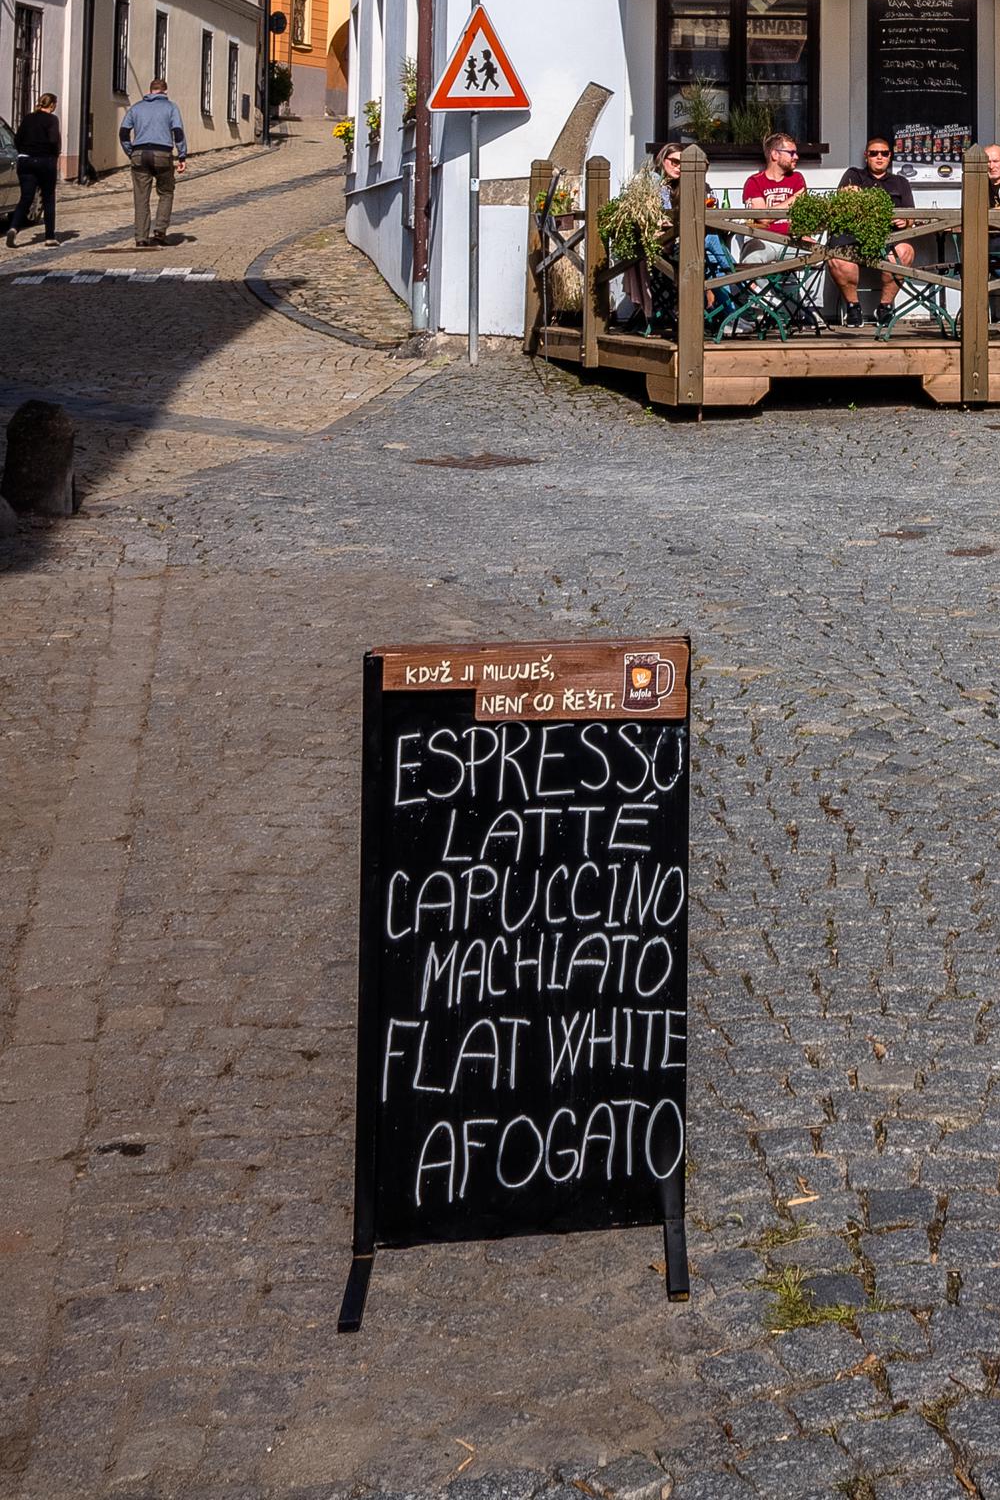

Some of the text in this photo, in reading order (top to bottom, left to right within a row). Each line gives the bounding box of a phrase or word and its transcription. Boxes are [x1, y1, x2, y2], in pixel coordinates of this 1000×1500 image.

[406, 654, 555, 684] KDYŽ JI MILUJEŠ,
[482, 688, 615, 714] NENÍ CO ŘEŠIT.
[630, 688, 652, 701] kofola
[394, 721, 684, 806] ESPRESSO
[386, 862, 685, 939] CAPUCCINO
[421, 932, 673, 1011] MACHIATO
[383, 1007, 686, 1102] FLAT WHITE
[416, 1099, 685, 1206] AFOGATO
